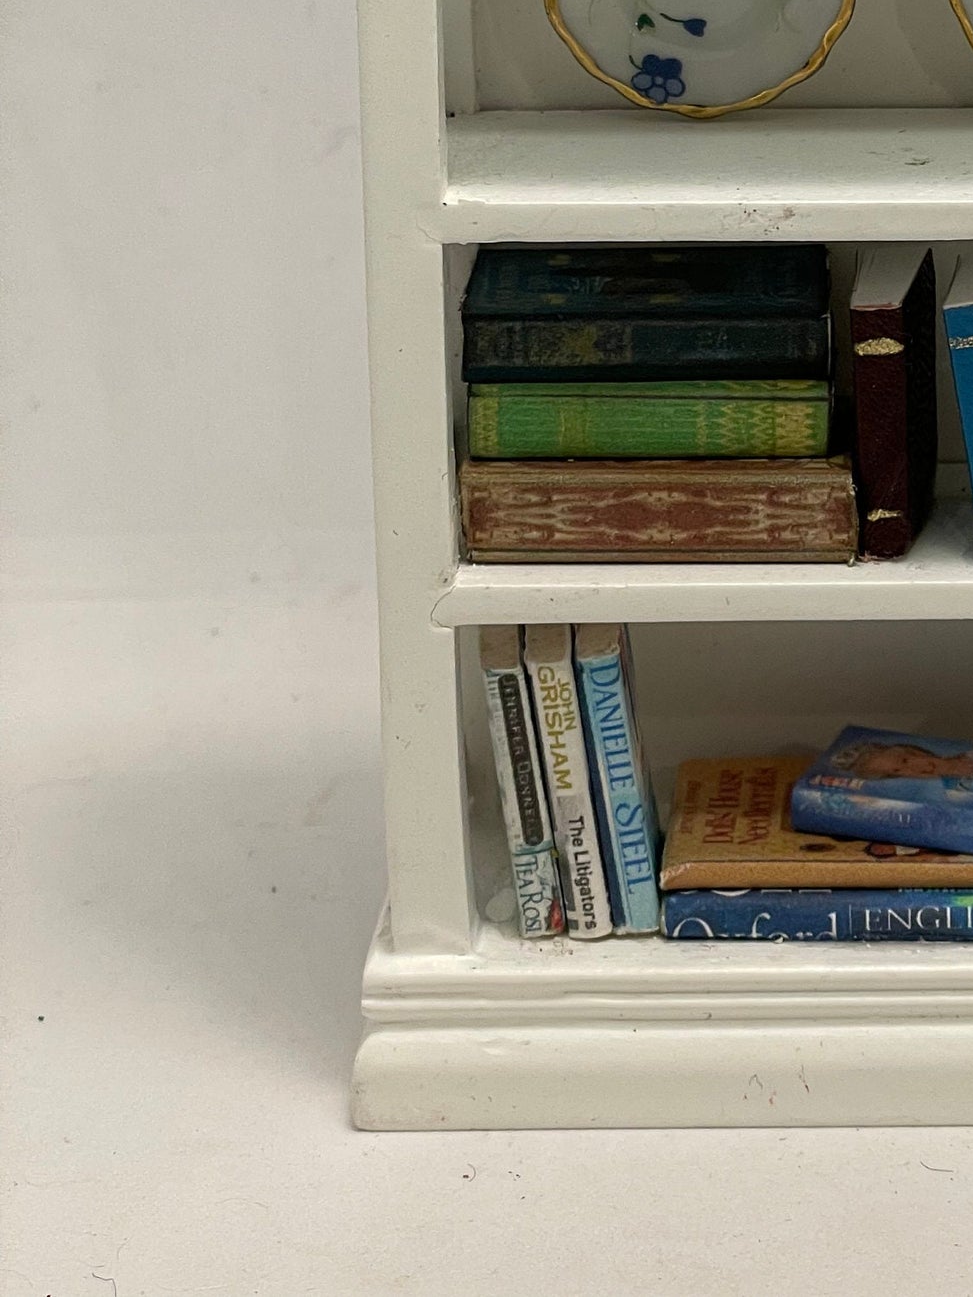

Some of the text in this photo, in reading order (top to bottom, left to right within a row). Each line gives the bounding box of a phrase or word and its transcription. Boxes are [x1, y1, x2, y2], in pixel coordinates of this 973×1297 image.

[537, 665, 573, 790] GRISHAM
[557, 680, 577, 731] JOHN
[589, 663, 655, 894] DANIELLE STEEL
[515, 855, 540, 893] TEA
[568, 815, 597, 931] The Litigators
